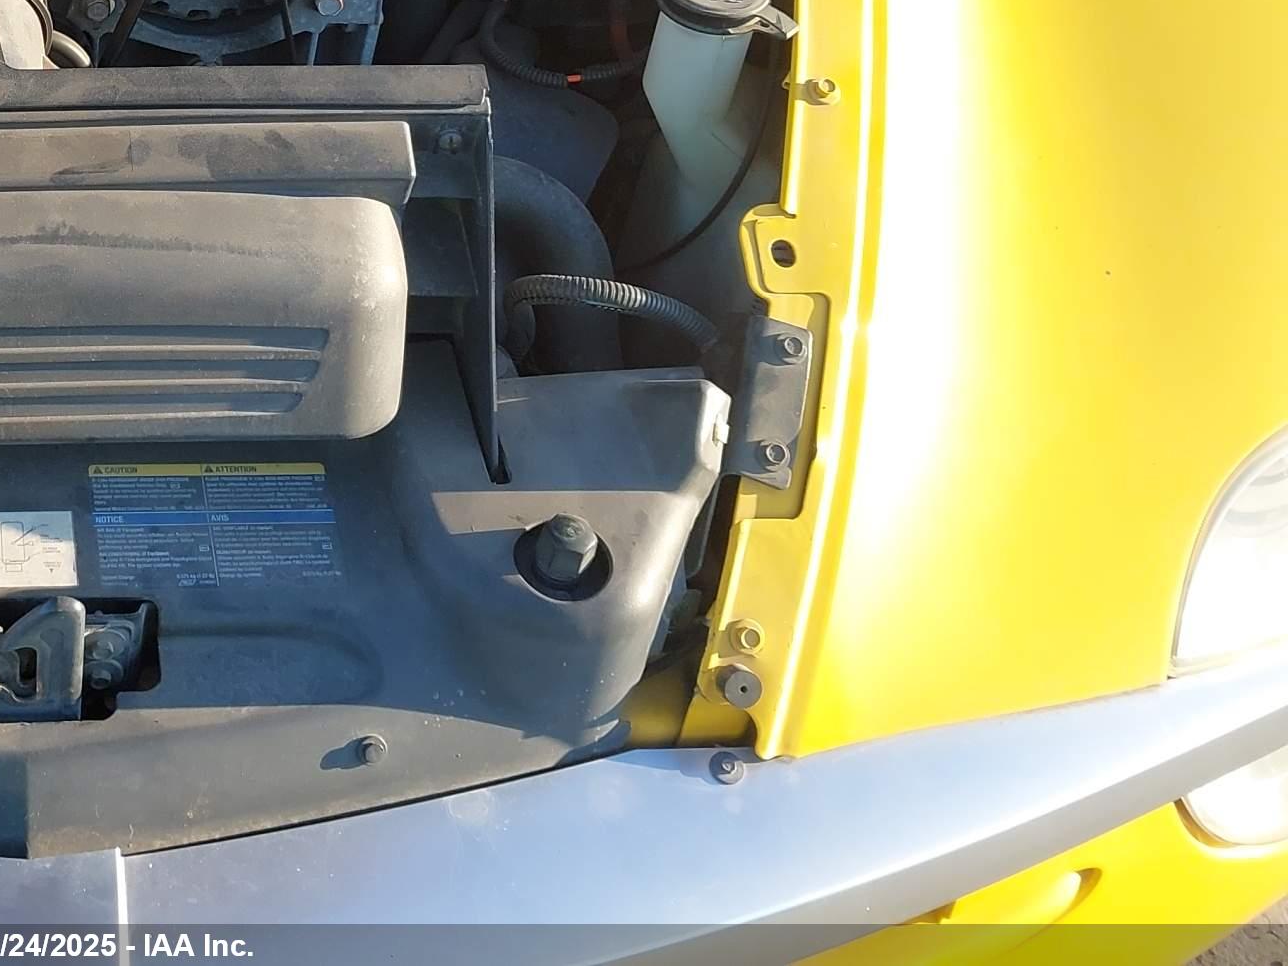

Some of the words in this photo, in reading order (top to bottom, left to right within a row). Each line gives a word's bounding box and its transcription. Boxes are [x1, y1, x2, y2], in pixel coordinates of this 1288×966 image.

[104, 465, 138, 474] CAUTION
[215, 465, 257, 473] ATTENTION
[95, 515, 124, 523] NOTICE
[211, 514, 230, 522] AVIS
